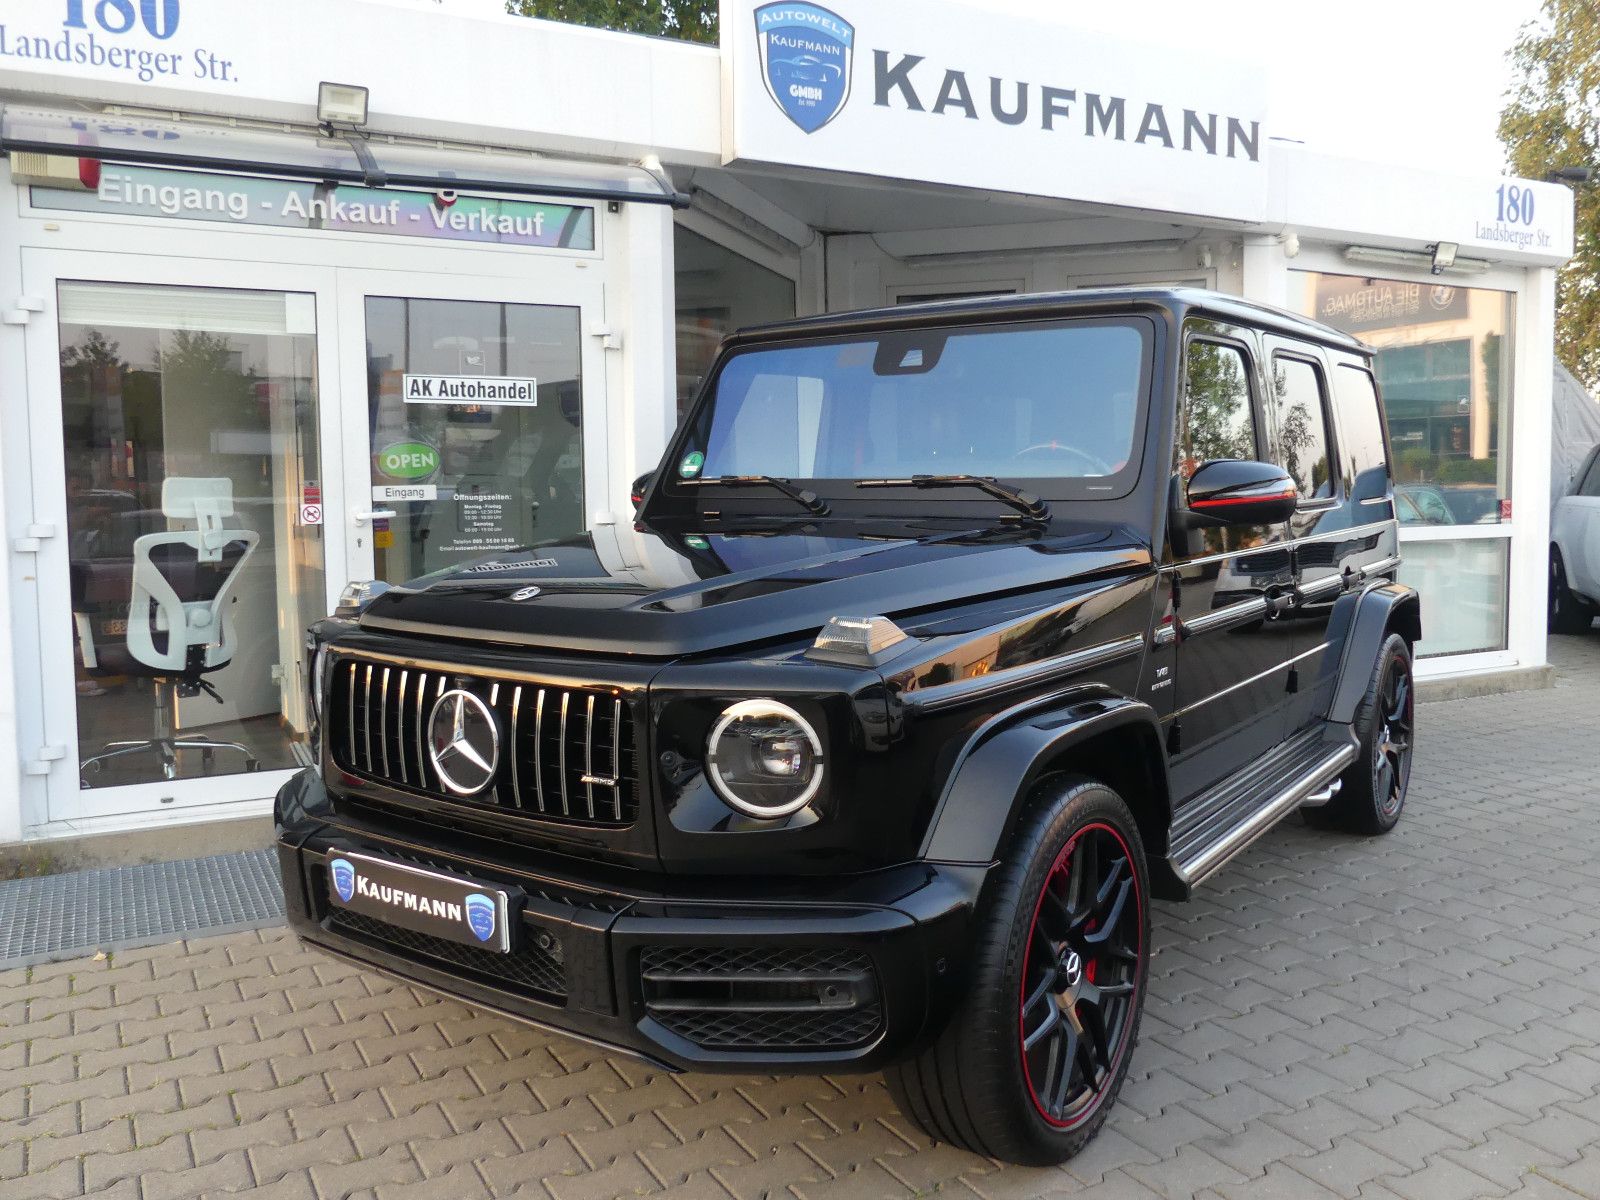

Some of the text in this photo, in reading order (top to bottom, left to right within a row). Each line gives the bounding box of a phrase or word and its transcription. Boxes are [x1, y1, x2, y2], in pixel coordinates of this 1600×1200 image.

[760, 11, 850, 38] AUTOWELT
[0, 24, 238, 83] Landsberger Str.
[770, 34, 840, 56] KAUFMANN
[789, 83, 823, 101] GMBH
[872, 48, 1261, 162] KAUFMANN
[99, 174, 249, 220] Eingang
[280, 190, 400, 226] Ankauf
[428, 203, 544, 237] Verkauf
[1496, 183, 1535, 226] 180
[1475, 220, 1534, 250] Landsberger
[410, 378, 532, 400] AK Autohandel
[386, 452, 434, 470] OPEN
[385, 487, 425, 499] Eingang
[356, 875, 462, 922] KAUFMANN
